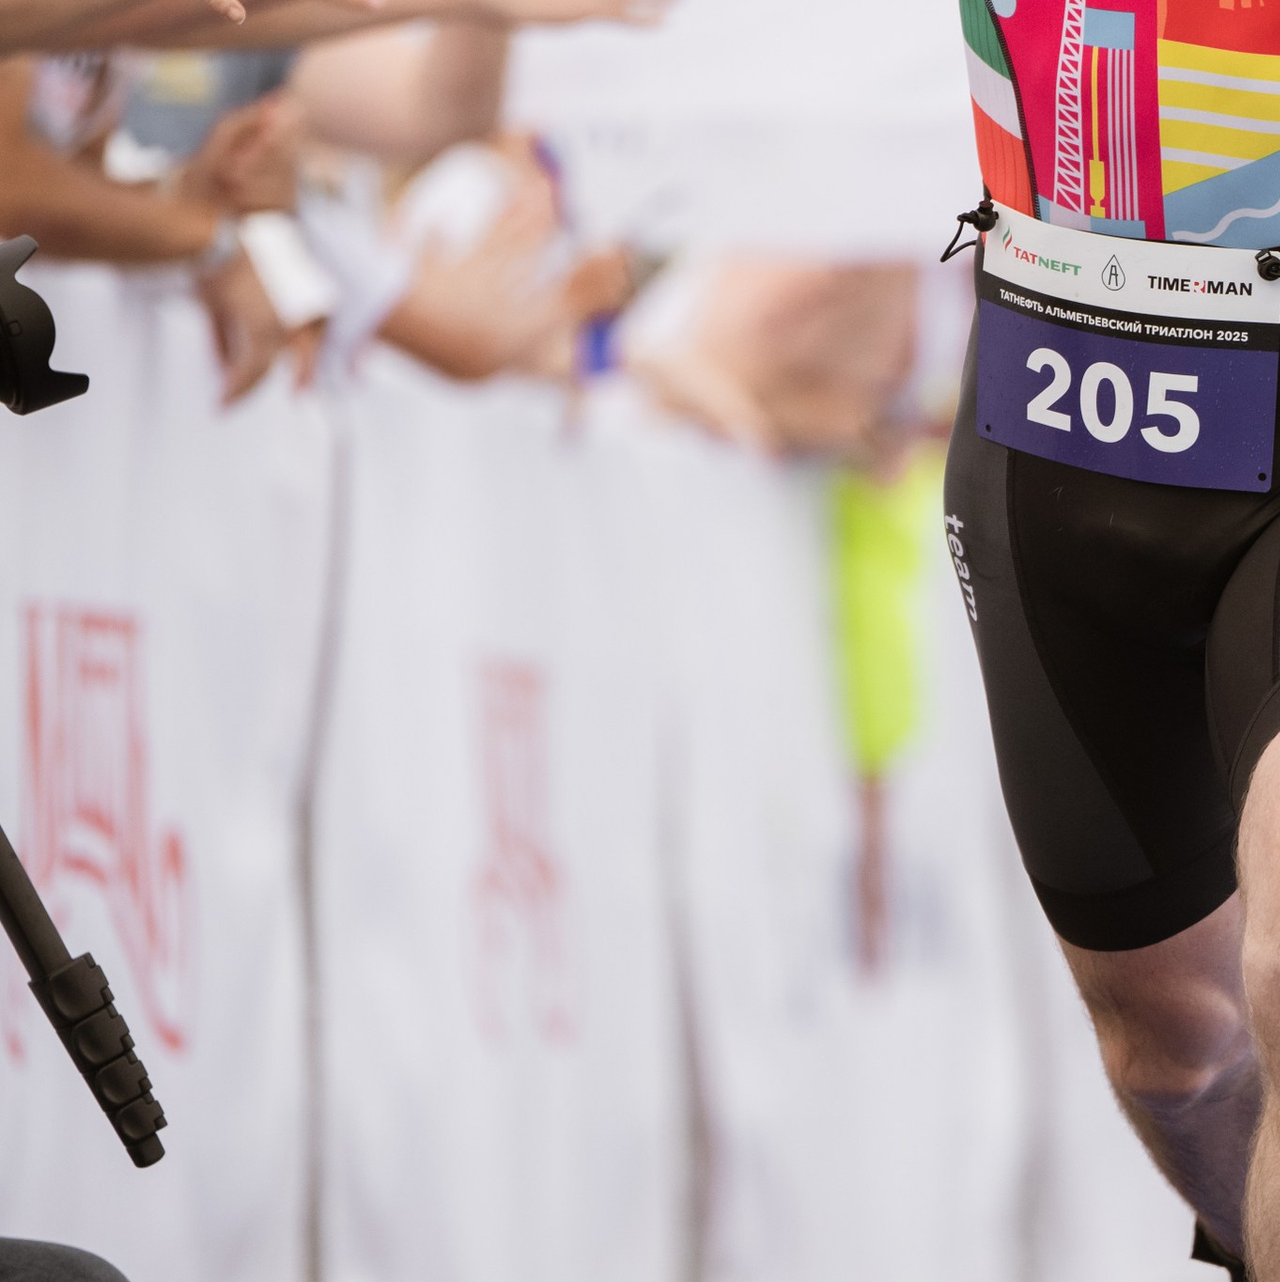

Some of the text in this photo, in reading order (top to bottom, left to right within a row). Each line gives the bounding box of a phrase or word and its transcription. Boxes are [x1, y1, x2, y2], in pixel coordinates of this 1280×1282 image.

[1013, 246, 1082, 276] TATNEFT
[999, 288, 1249, 343] ТАТНЕФТЬ АЛЬМЕТЬЕВСКИЙ ТРИАТЛОН 2025
[1025, 347, 1200, 453] 205
